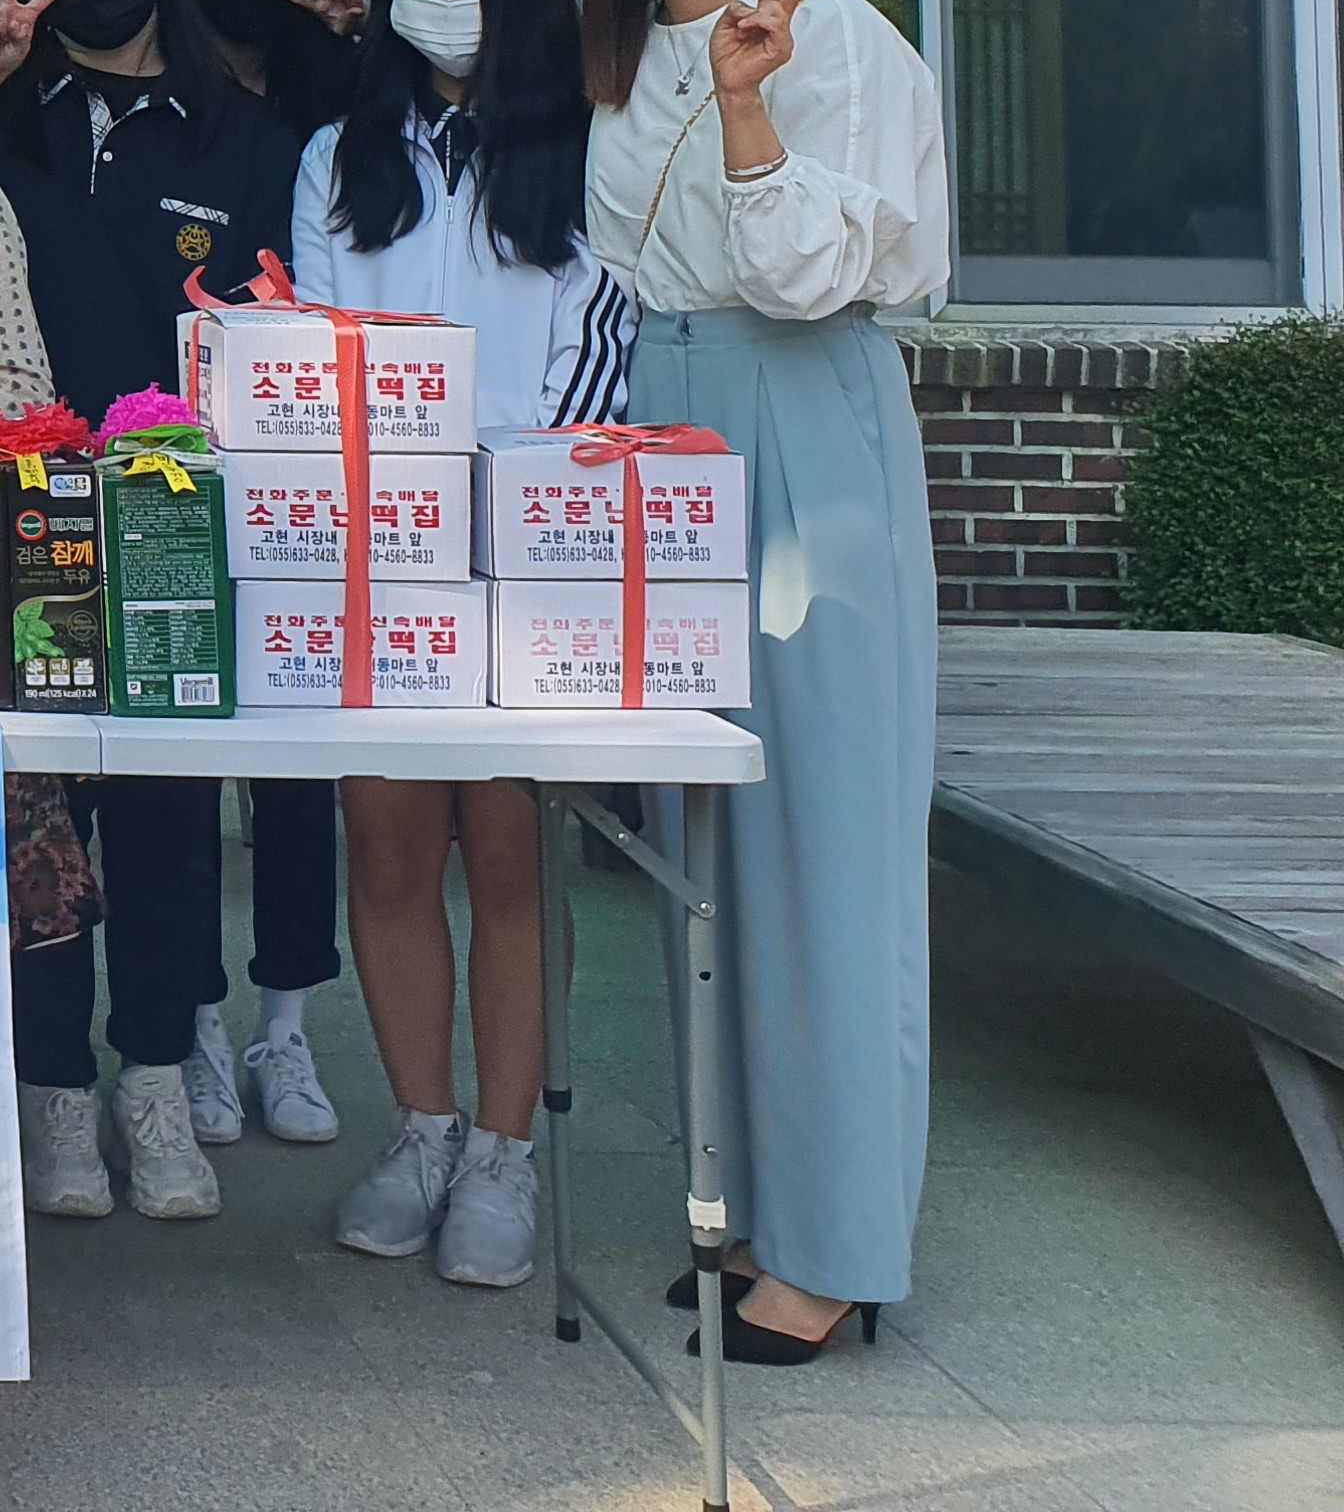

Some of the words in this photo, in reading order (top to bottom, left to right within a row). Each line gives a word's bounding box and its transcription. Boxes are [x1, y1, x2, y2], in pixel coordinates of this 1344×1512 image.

[252, 377, 339, 400] 소문
[377, 377, 446, 400] 떡집
[267, 404, 294, 418] 고현
[366, 405, 407, 419] 동마트
[415, 405, 428, 420] 앞
[376, 490, 439, 502] 속배달
[641, 486, 712, 498] 속배달
[371, 505, 440, 528] 떡집
[646, 501, 714, 524] 떡집
[261, 530, 288, 544] 고현
[296, 531, 337, 545] 시장내
[409, 532, 421, 547] 앞
[538, 529, 565, 544] 고현
[685, 530, 698, 544] 앞
[16, 545, 48, 565] 검은
[50, 540, 94, 566] 참깨
[369, 549, 434, 564] 10-4560-8833
[646, 547, 711, 562] 10-4560-8833
[63, 569, 91, 584] 두유
[647, 618, 719, 630] 속배달
[389, 631, 456, 654] 떡집
[279, 657, 306, 671] 고현
[315, 658, 341, 672] 시장
[371, 657, 418, 672] 동마트
[426, 658, 438, 673] 앞
[546, 661, 572, 676] 고현
[643, 661, 683, 676] 동마트
[691, 661, 704, 676] 앞
[267, 673, 342, 688] TEL:(055)633-04
